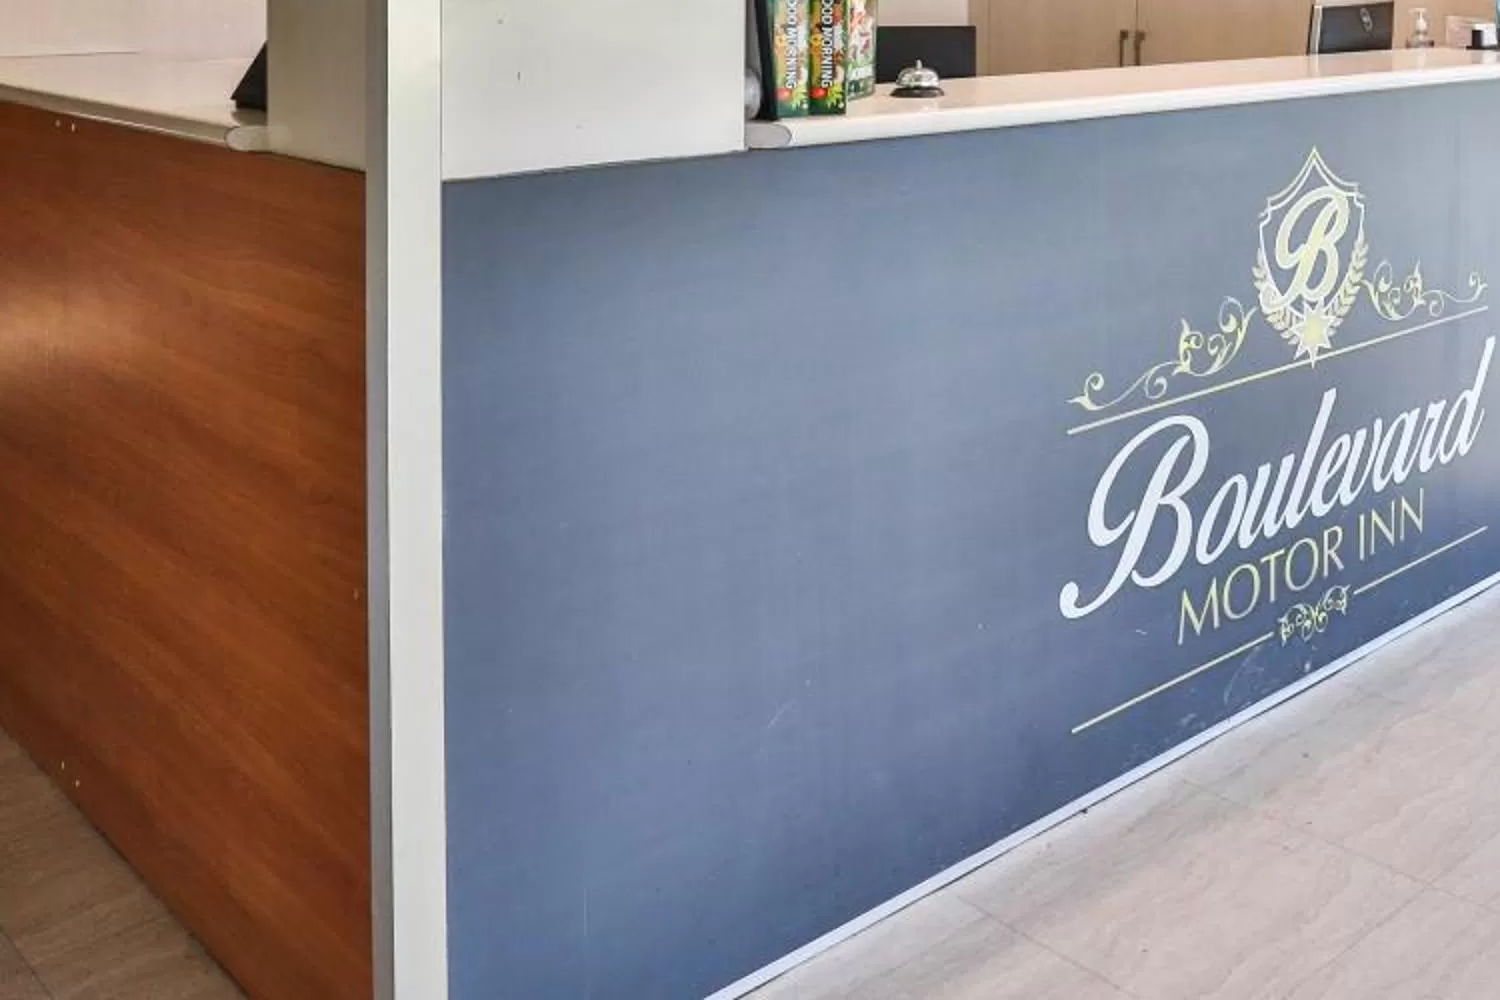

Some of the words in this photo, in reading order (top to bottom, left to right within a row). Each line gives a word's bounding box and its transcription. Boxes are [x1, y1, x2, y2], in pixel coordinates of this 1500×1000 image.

[820, 27, 833, 89] MORNING
[1274, 185, 1352, 301] B
[1059, 336, 1496, 620] Boulevard
[1177, 524, 1344, 646] MOTOR
[1357, 487, 1425, 561] INN
